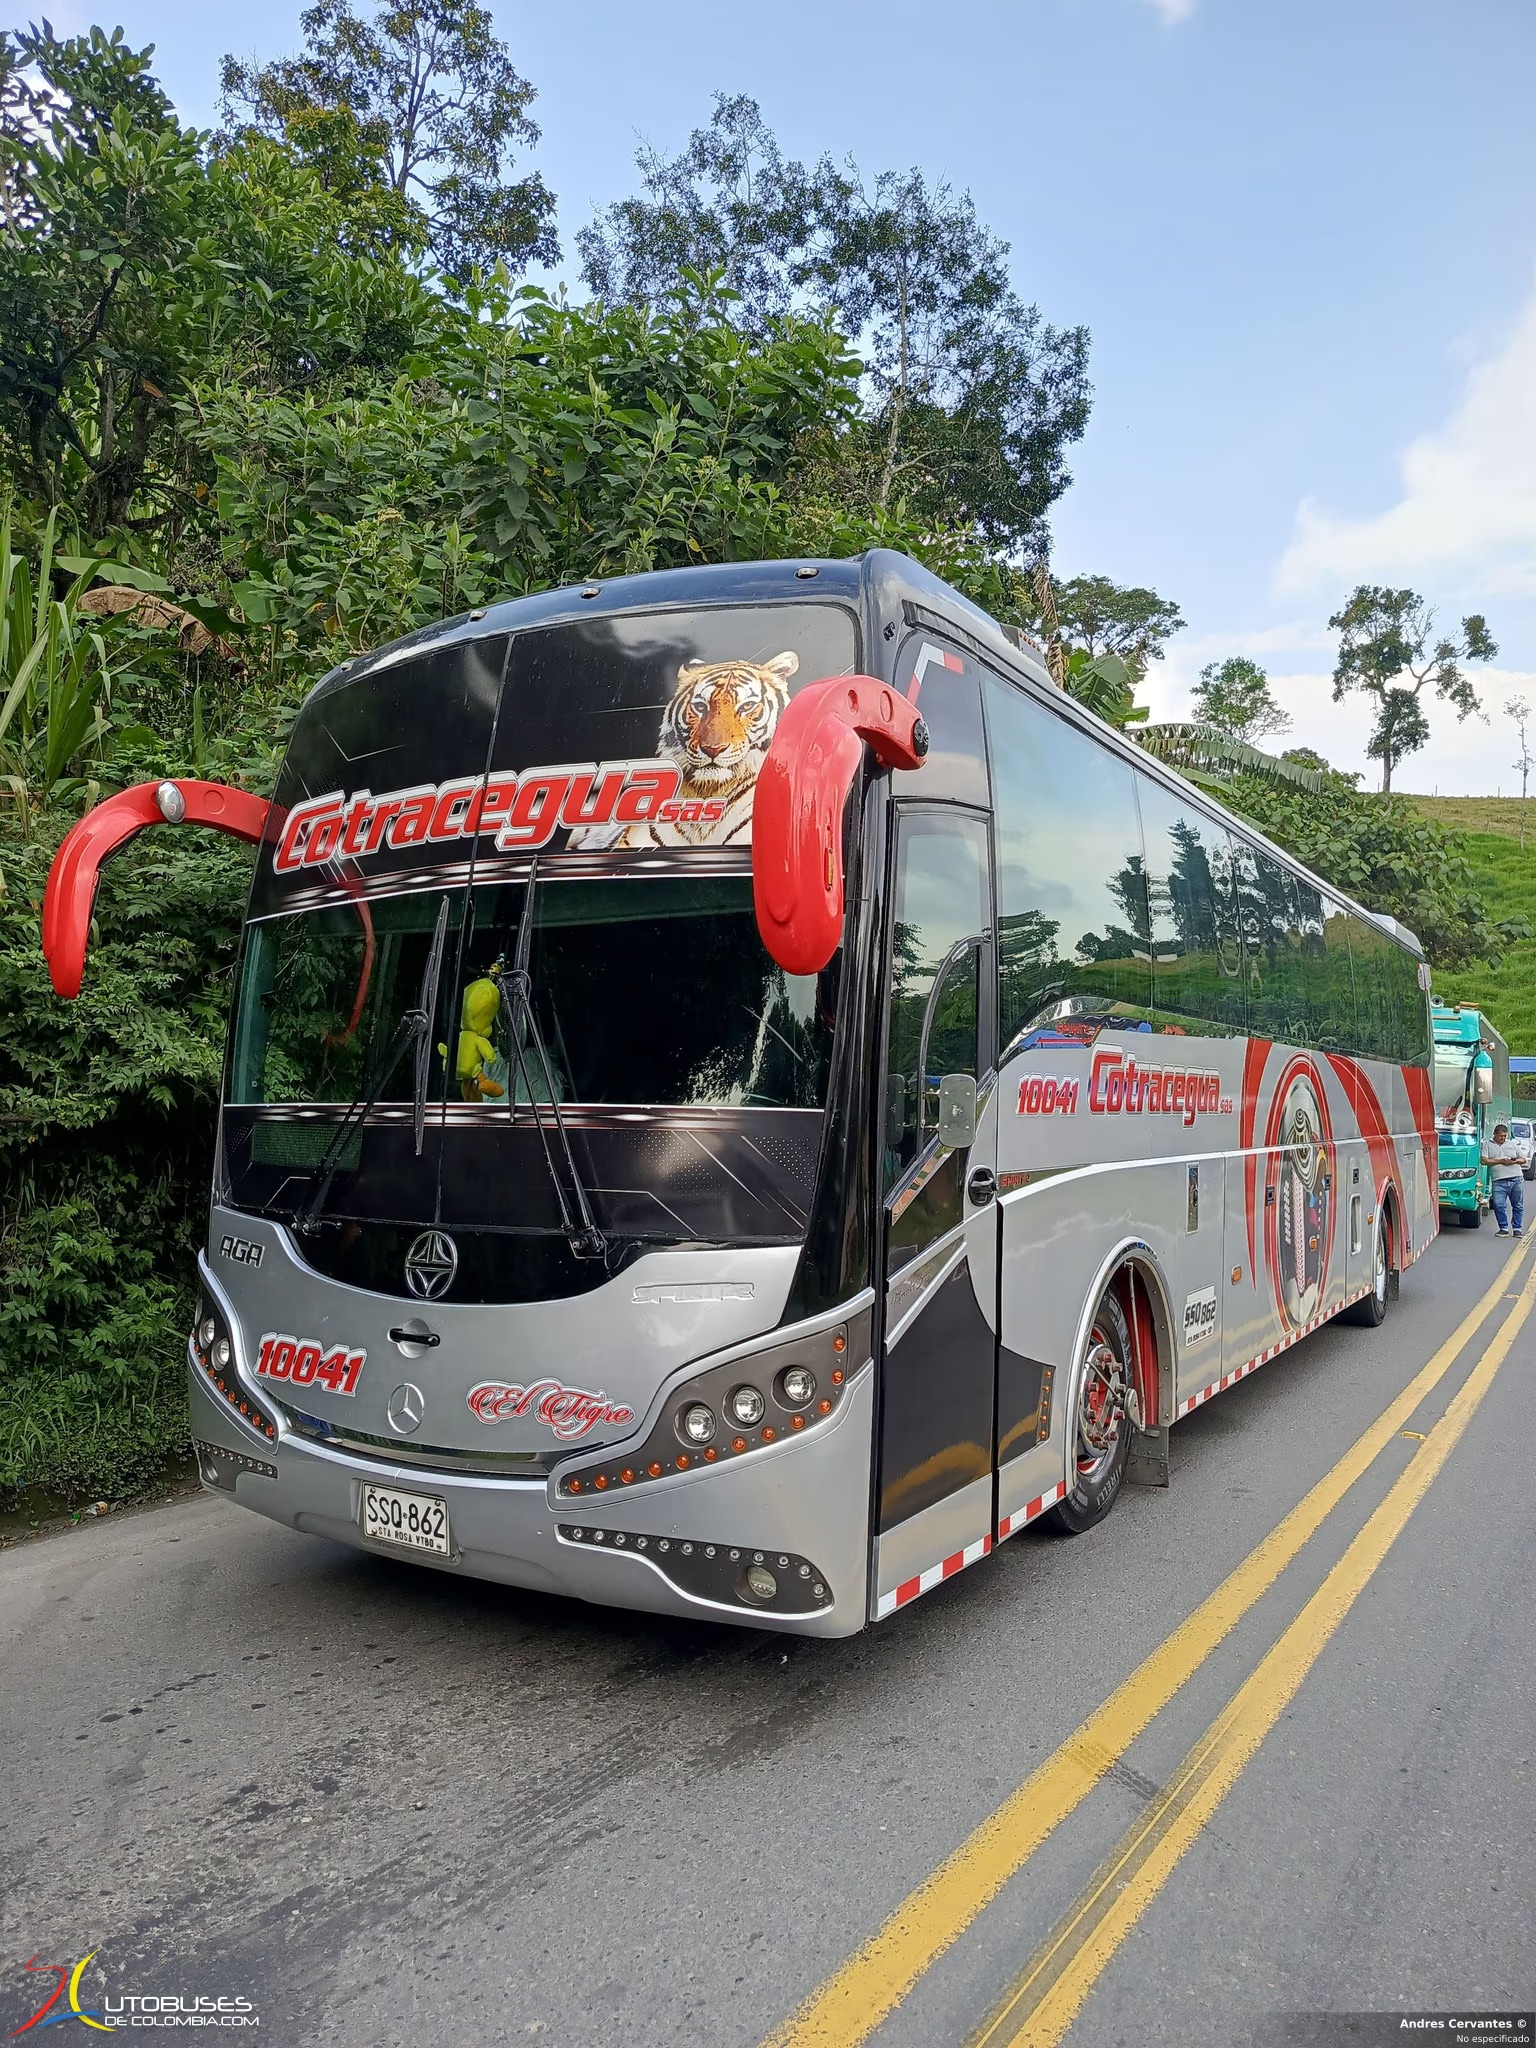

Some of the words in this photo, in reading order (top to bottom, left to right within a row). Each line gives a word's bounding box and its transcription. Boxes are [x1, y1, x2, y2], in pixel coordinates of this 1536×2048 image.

[273, 759, 683, 874] Cotracegua
[1016, 1073, 1080, 1117] 10041
[1089, 1043, 1220, 1129] Cotracegua
[221, 1235, 265, 1268] AGA
[254, 1332, 368, 1398] 10041
[466, 1379, 540, 1425] El
[534, 1378, 636, 1441] Tigre
[378, 1526, 391, 1537] STA
[395, 1530, 413, 1543] ROSA
